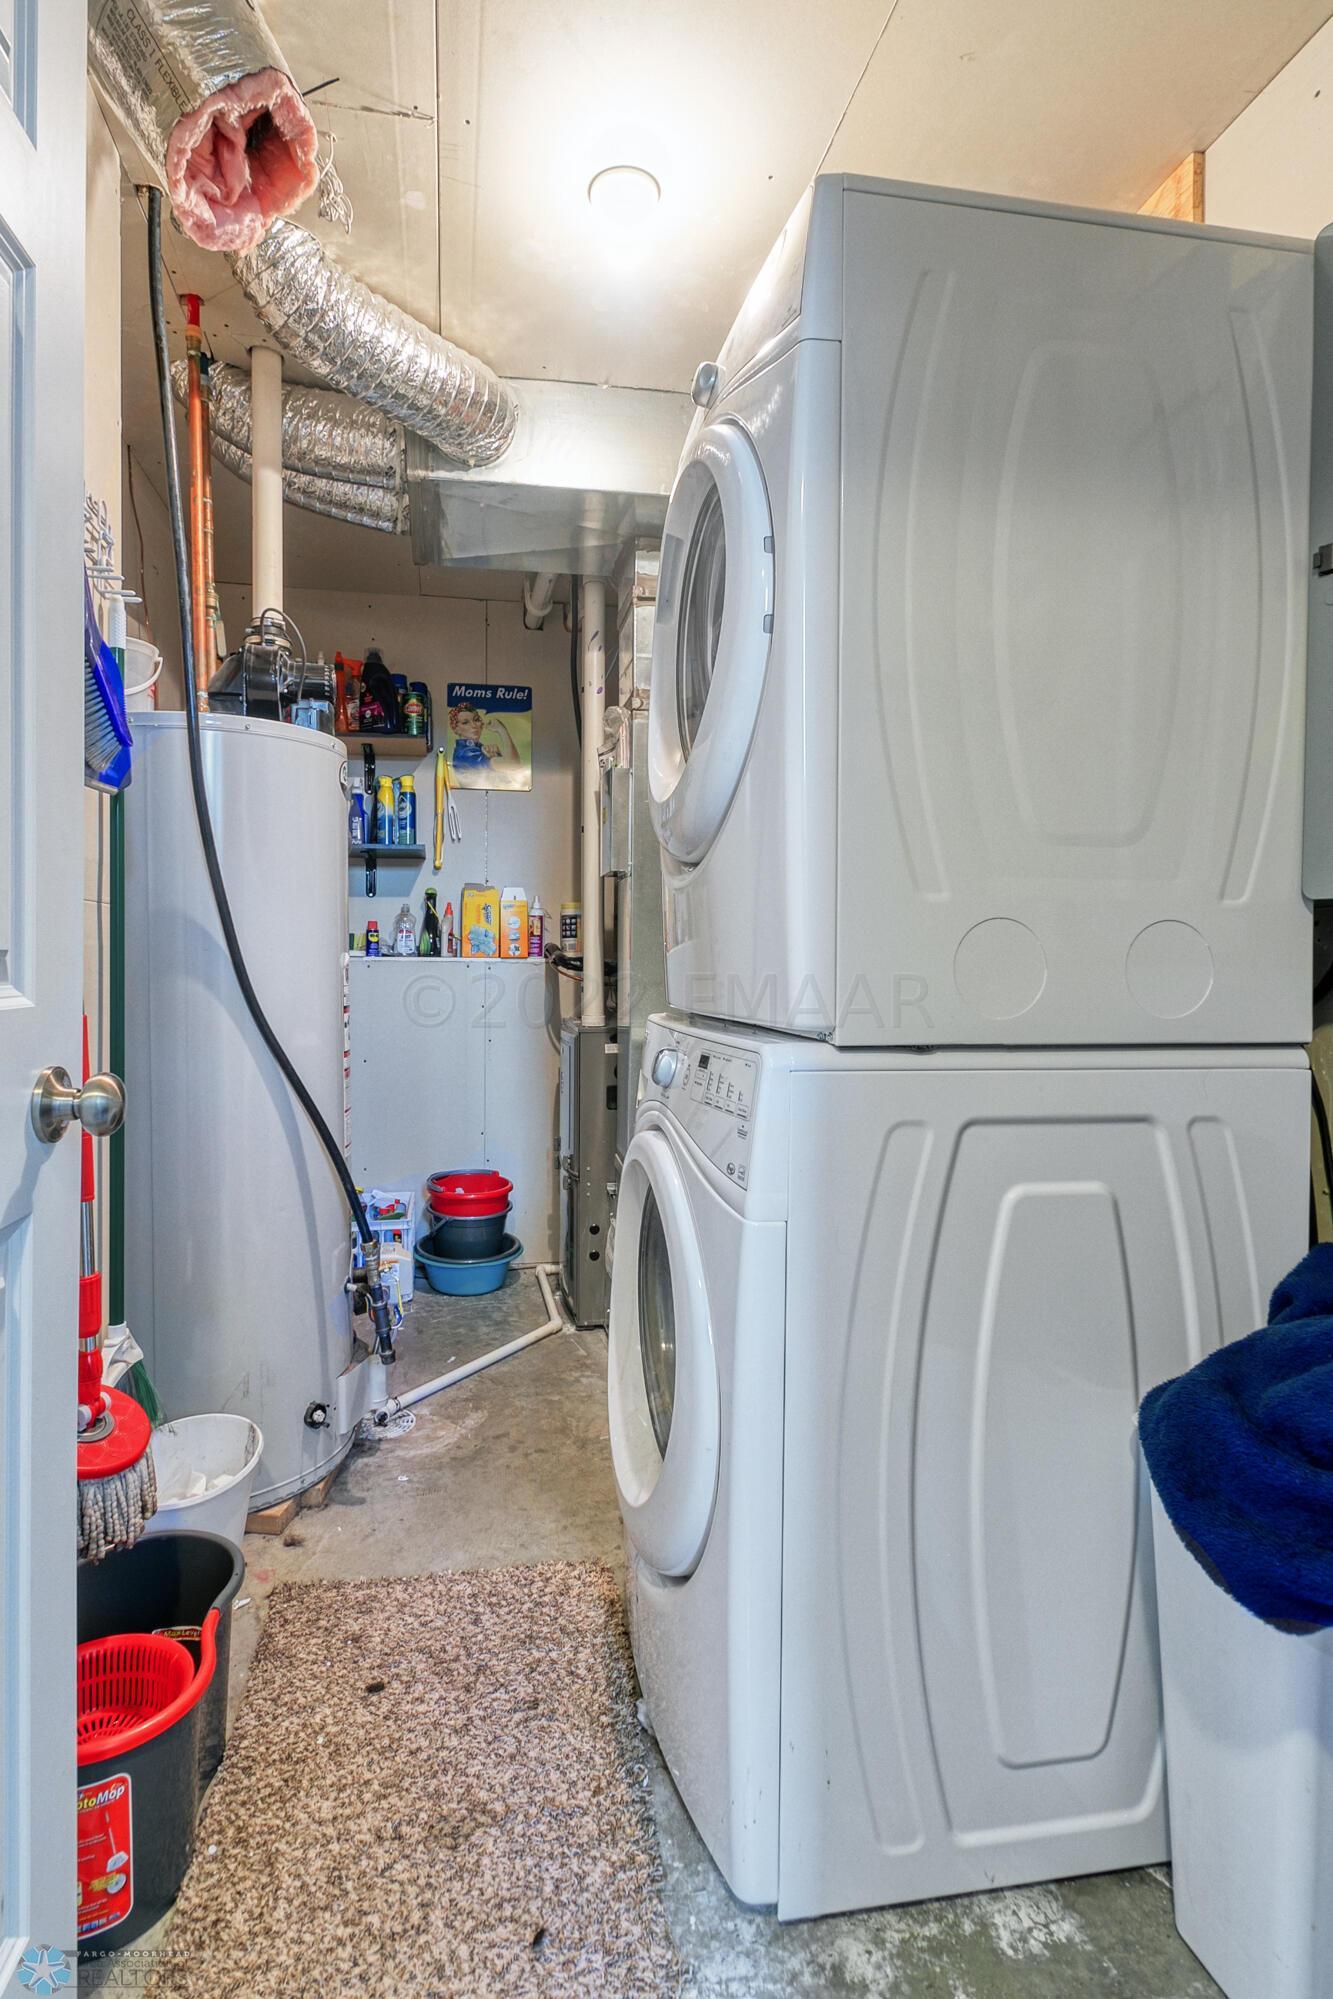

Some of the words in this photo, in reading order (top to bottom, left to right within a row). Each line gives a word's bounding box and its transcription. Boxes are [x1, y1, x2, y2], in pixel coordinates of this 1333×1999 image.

[127, 8, 151, 49] CLASS
[155, 58, 188, 110] FLEXIBLE
[452, 685, 492, 698] Moms
[496, 687, 529, 700] Rule!
